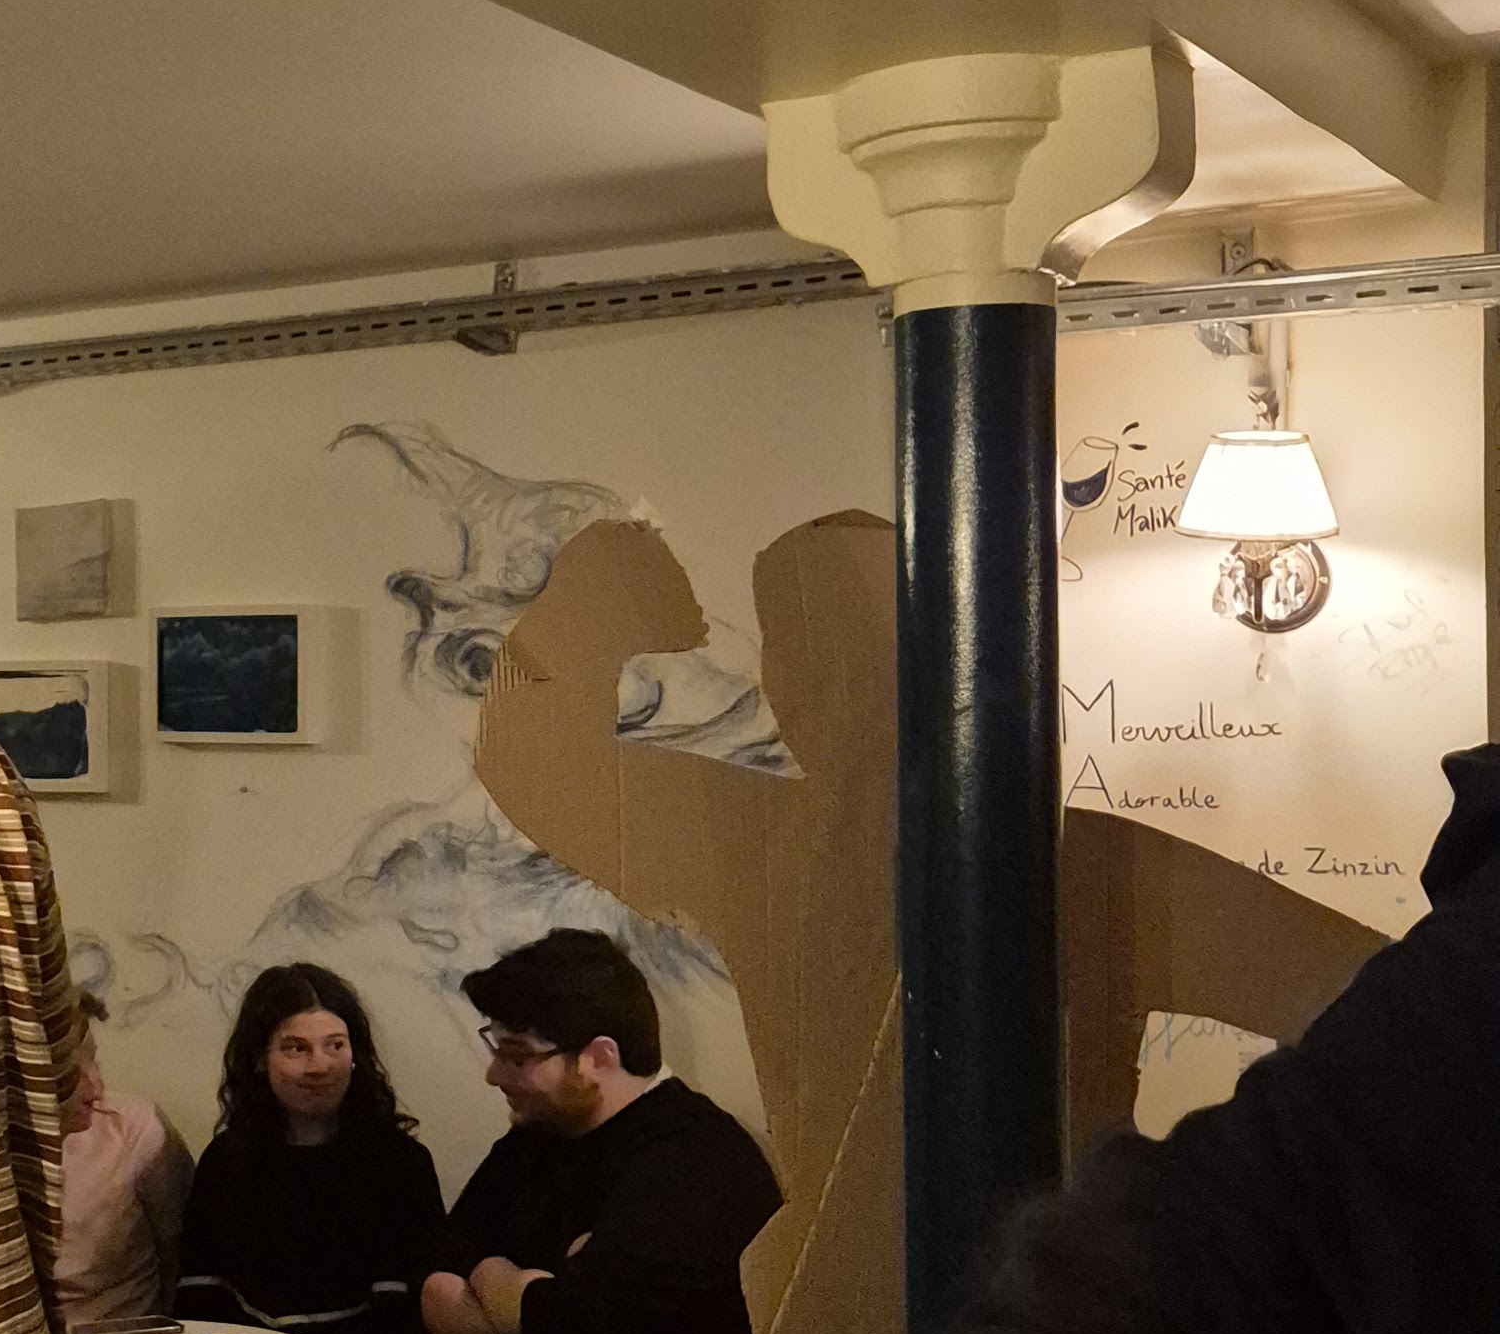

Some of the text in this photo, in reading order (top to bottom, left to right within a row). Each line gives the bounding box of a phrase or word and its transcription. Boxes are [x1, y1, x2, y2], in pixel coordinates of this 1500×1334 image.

[1117, 460, 1187, 502] Santé
[1061, 679, 1282, 744] Merveilleux
[1065, 753, 1220, 809] Adorable
[1257, 847, 1405, 877] de Zinzin
